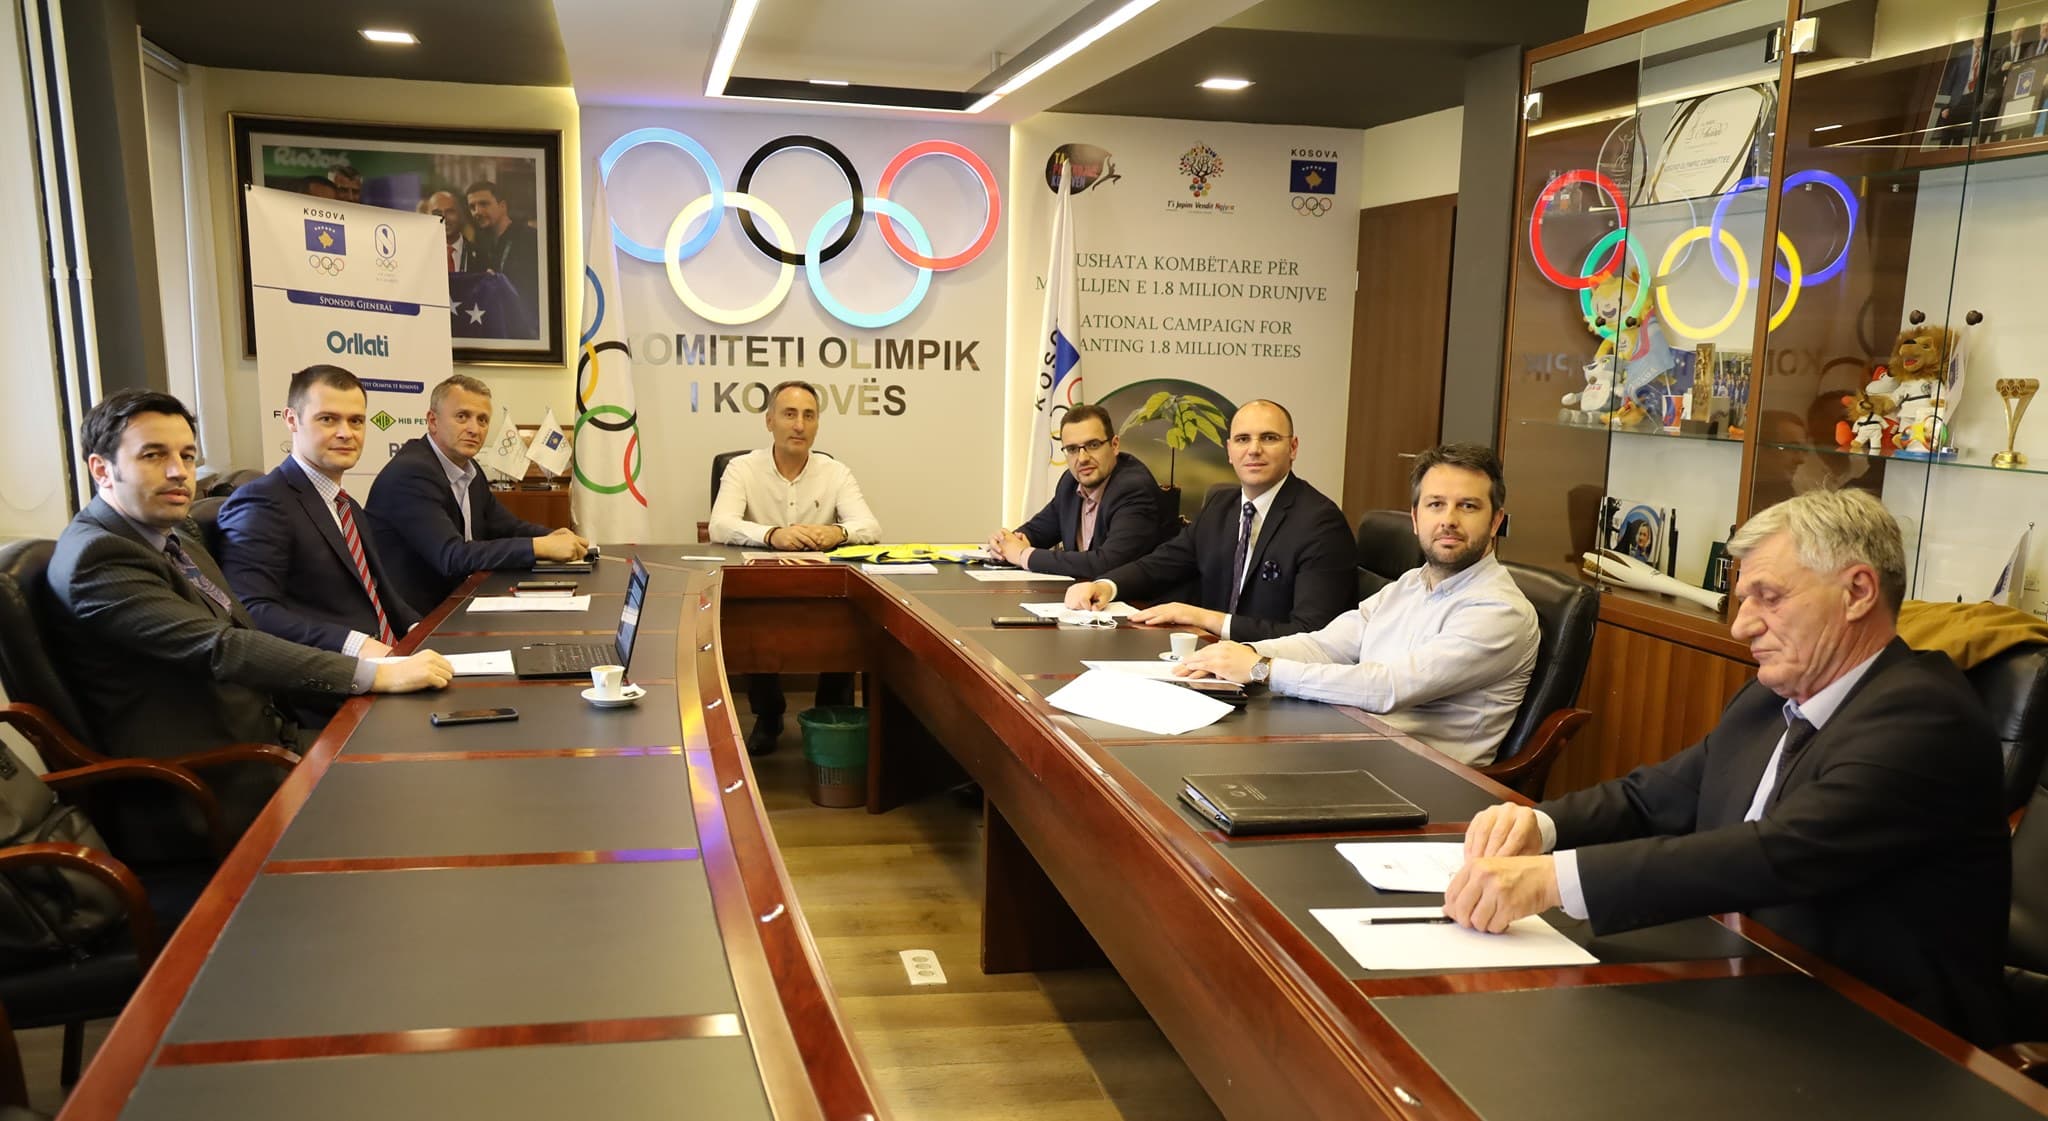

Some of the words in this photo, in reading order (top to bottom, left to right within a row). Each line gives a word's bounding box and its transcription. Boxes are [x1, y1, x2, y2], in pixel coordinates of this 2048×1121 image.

[1290, 148, 1338, 159] KOSOVA
[303, 207, 345, 221] KOSOVA
[1076, 253, 1147, 270] USHATA
[1154, 256, 1262, 275] KOMBËTARE
[1268, 259, 1299, 276] PËR
[1137, 280, 1147, 294] E
[1153, 281, 1174, 295] 1.8
[1179, 281, 1244, 298] MILION
[1249, 284, 1327, 303] DRUNJVE
[319, 296, 356, 309] SPONSOR
[356, 300, 393, 312] GJENERAL
[1080, 314, 1158, 330] ATIONAL
[1163, 317, 1255, 333] CAMPAIGN
[1260, 320, 1292, 335] FOR
[326, 330, 389, 357] Orllati
[818, 336, 981, 371] OLIMPIK
[1080, 338, 1144, 353] ANTING
[1151, 340, 1170, 354] 1.8
[1175, 340, 1247, 357] MILLION
[1252, 343, 1301, 359] TREES
[690, 380, 698, 413] I
